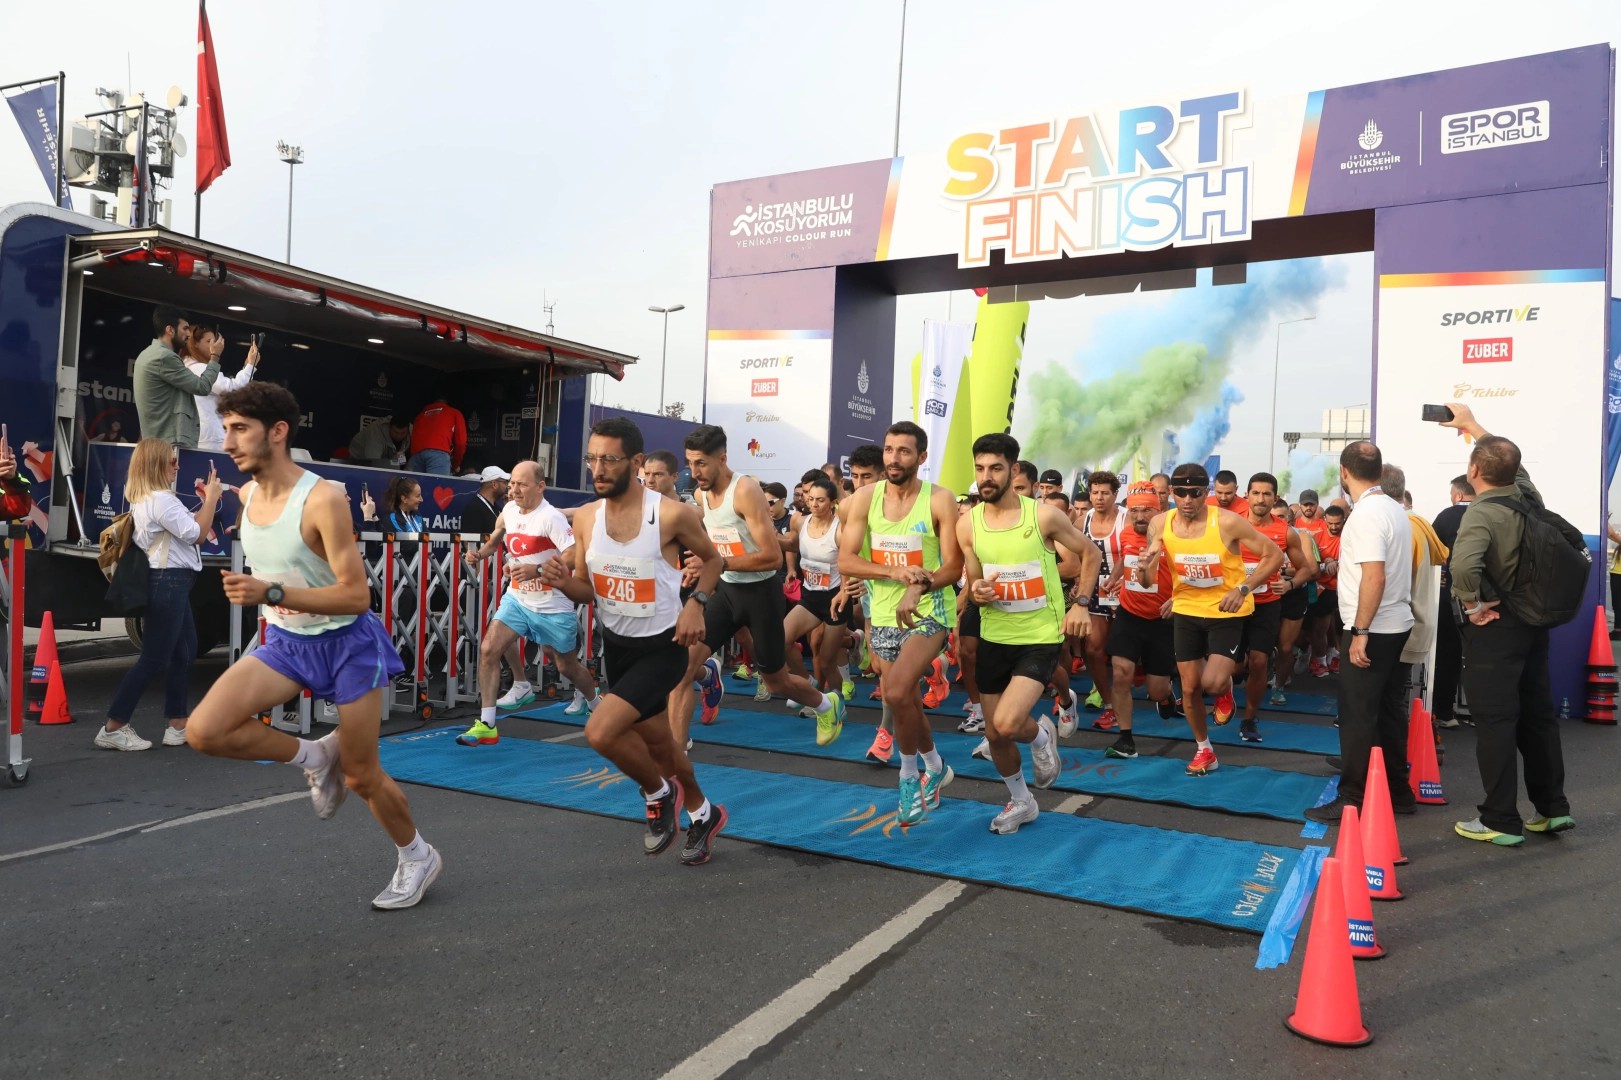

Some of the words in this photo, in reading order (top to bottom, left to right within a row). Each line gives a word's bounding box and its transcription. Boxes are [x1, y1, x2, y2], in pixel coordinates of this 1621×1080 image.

[1447, 106, 1541, 137] SPOR
[943, 91, 1240, 196] START
[1349, 164, 1392, 175] BELEDİYESİ
[758, 193, 854, 221] İSTANBULU
[964, 166, 1249, 263] FINISH
[736, 236, 782, 248] YENİKAPI
[785, 231, 827, 243] COLOUR
[830, 229, 851, 239] RUN
[1440, 304, 1540, 327] SPORTIVE
[1466, 342, 1509, 359] ZÜBER
[739, 356, 794, 369] SPORTIVE
[78, 379, 136, 403] stan
[753, 382, 777, 394] ZÜBER
[1471, 388, 1519, 398] Tchibo
[431, 514, 462, 530] Akti
[883, 551, 908, 568] 319
[805, 570, 823, 586] 1887
[1183, 564, 1212, 579] 3551
[606, 577, 636, 603] 246
[999, 581, 1028, 601] 711
